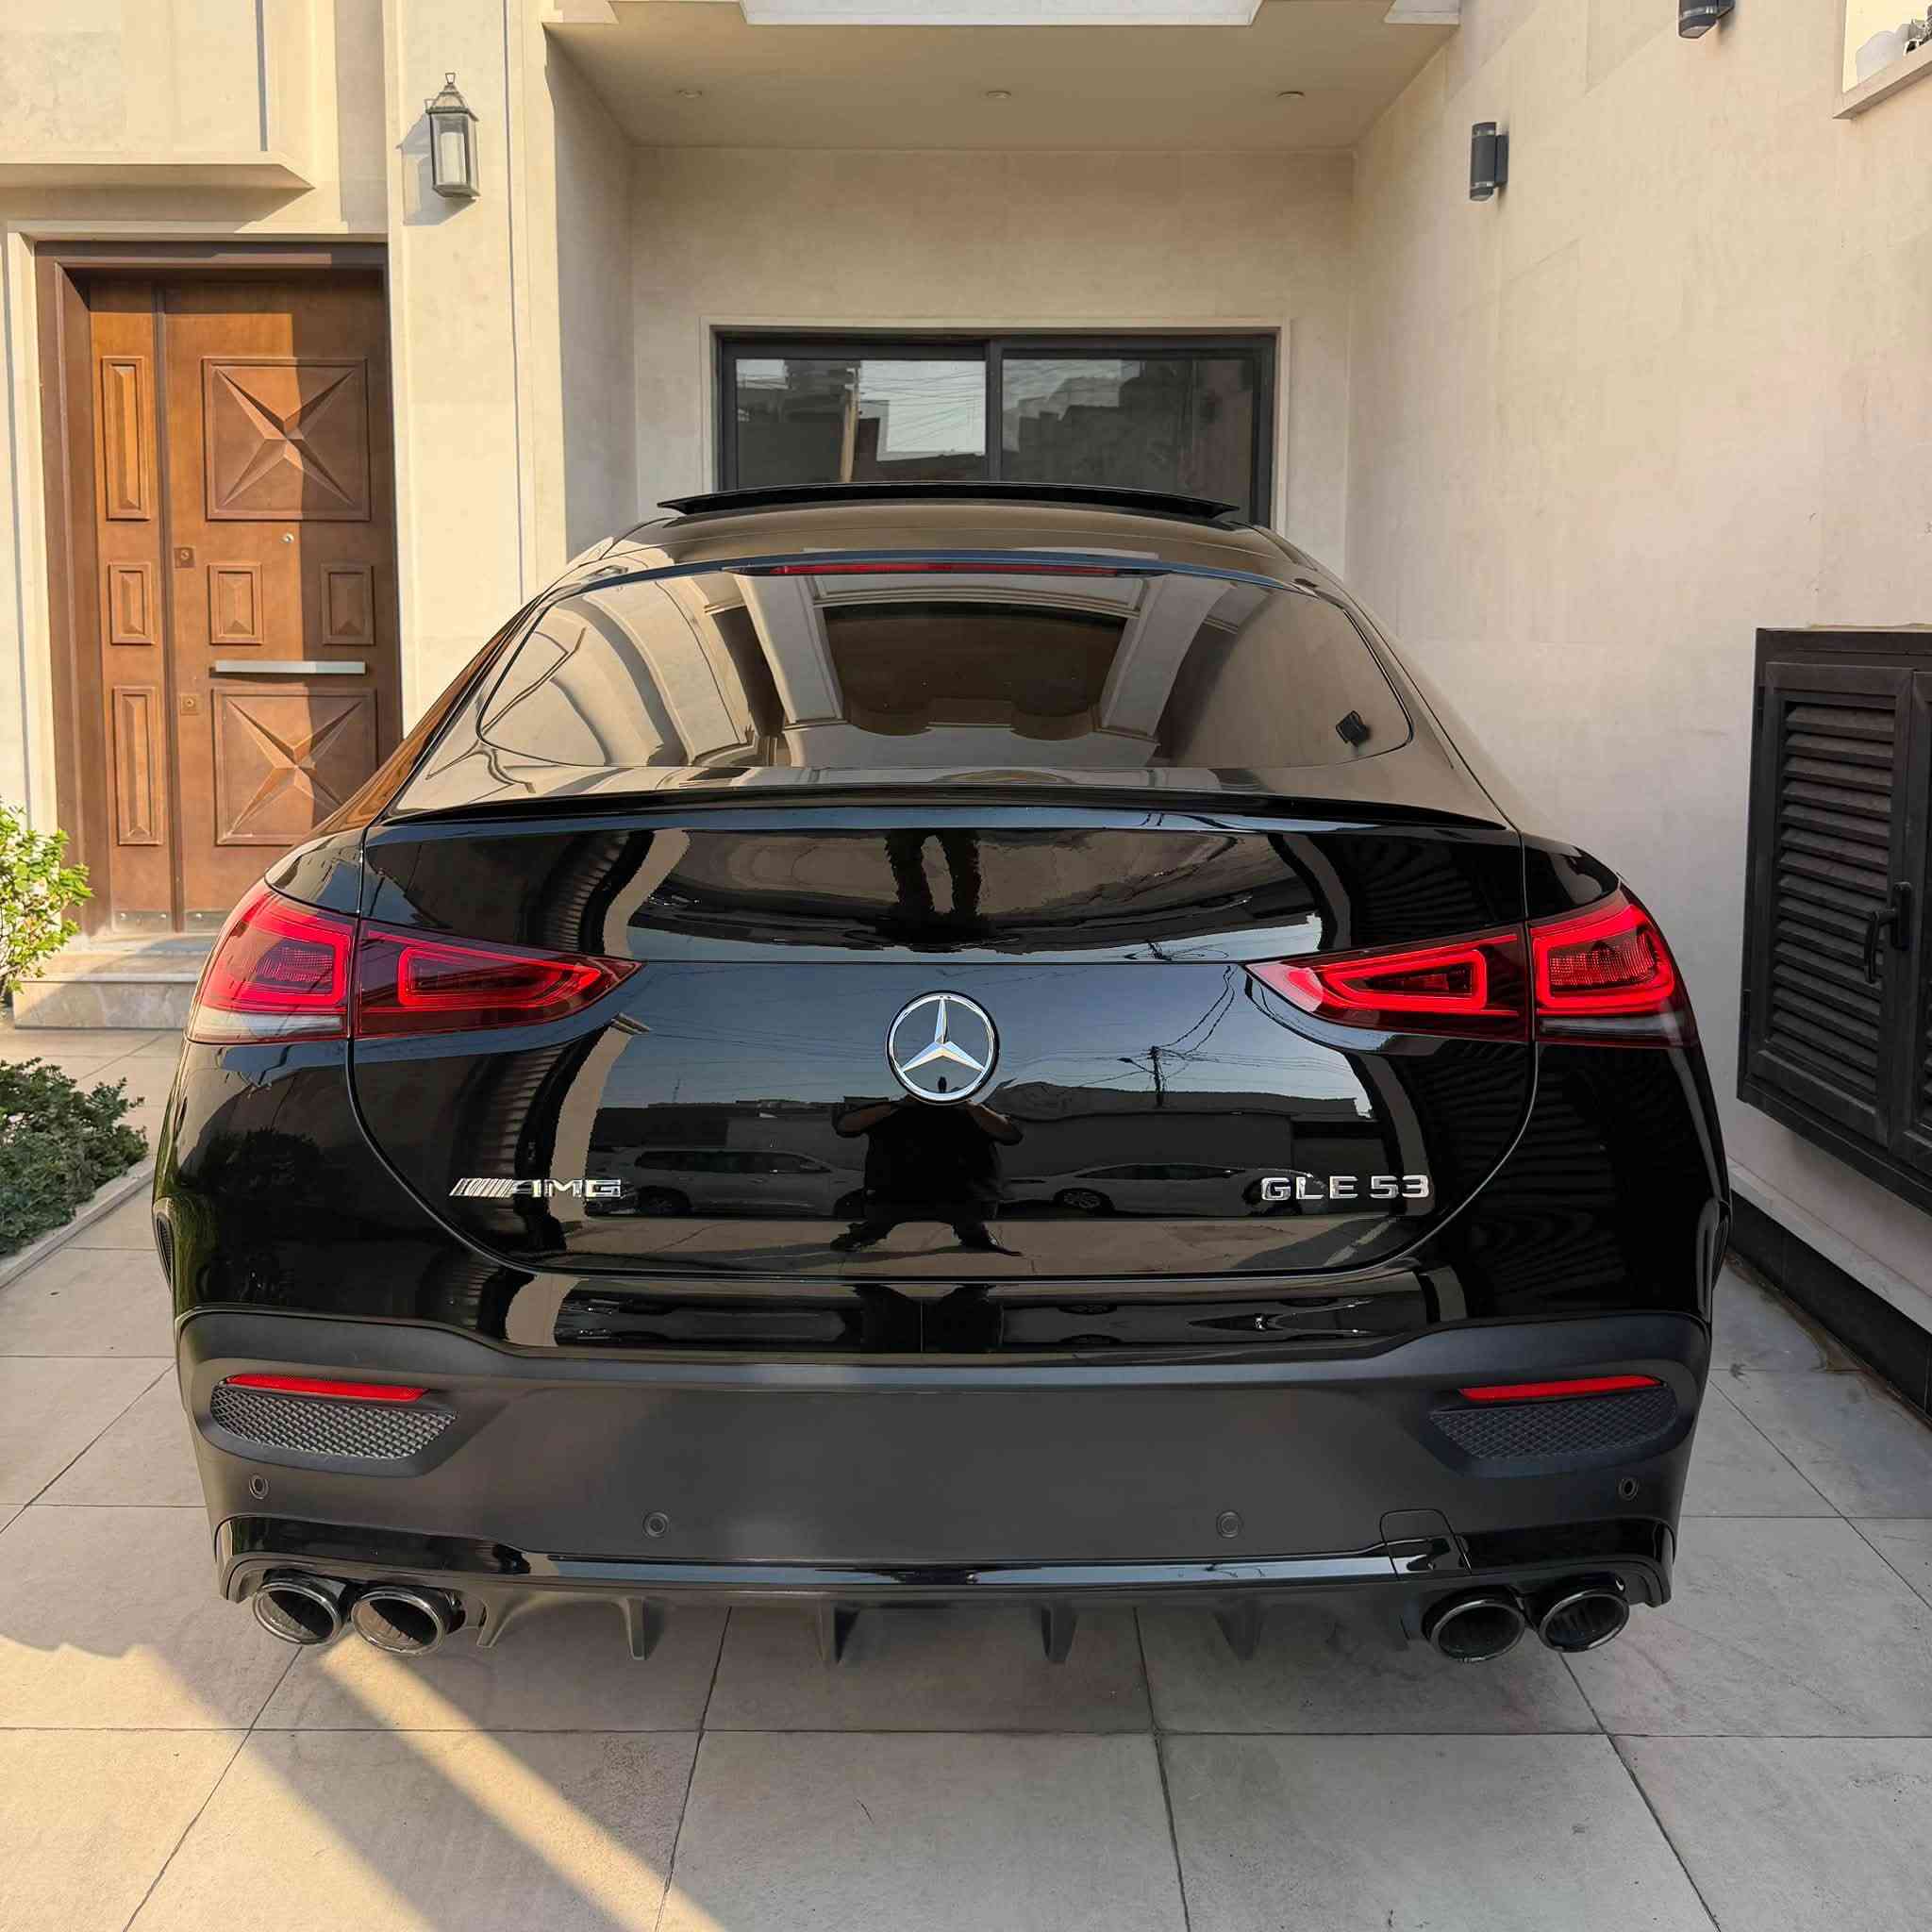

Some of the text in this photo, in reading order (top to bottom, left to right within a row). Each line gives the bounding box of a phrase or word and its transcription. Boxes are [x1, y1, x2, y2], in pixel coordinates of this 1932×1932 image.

[509, 1178, 622, 1198] AMG
[1260, 1174, 1430, 1201] GLE 53
